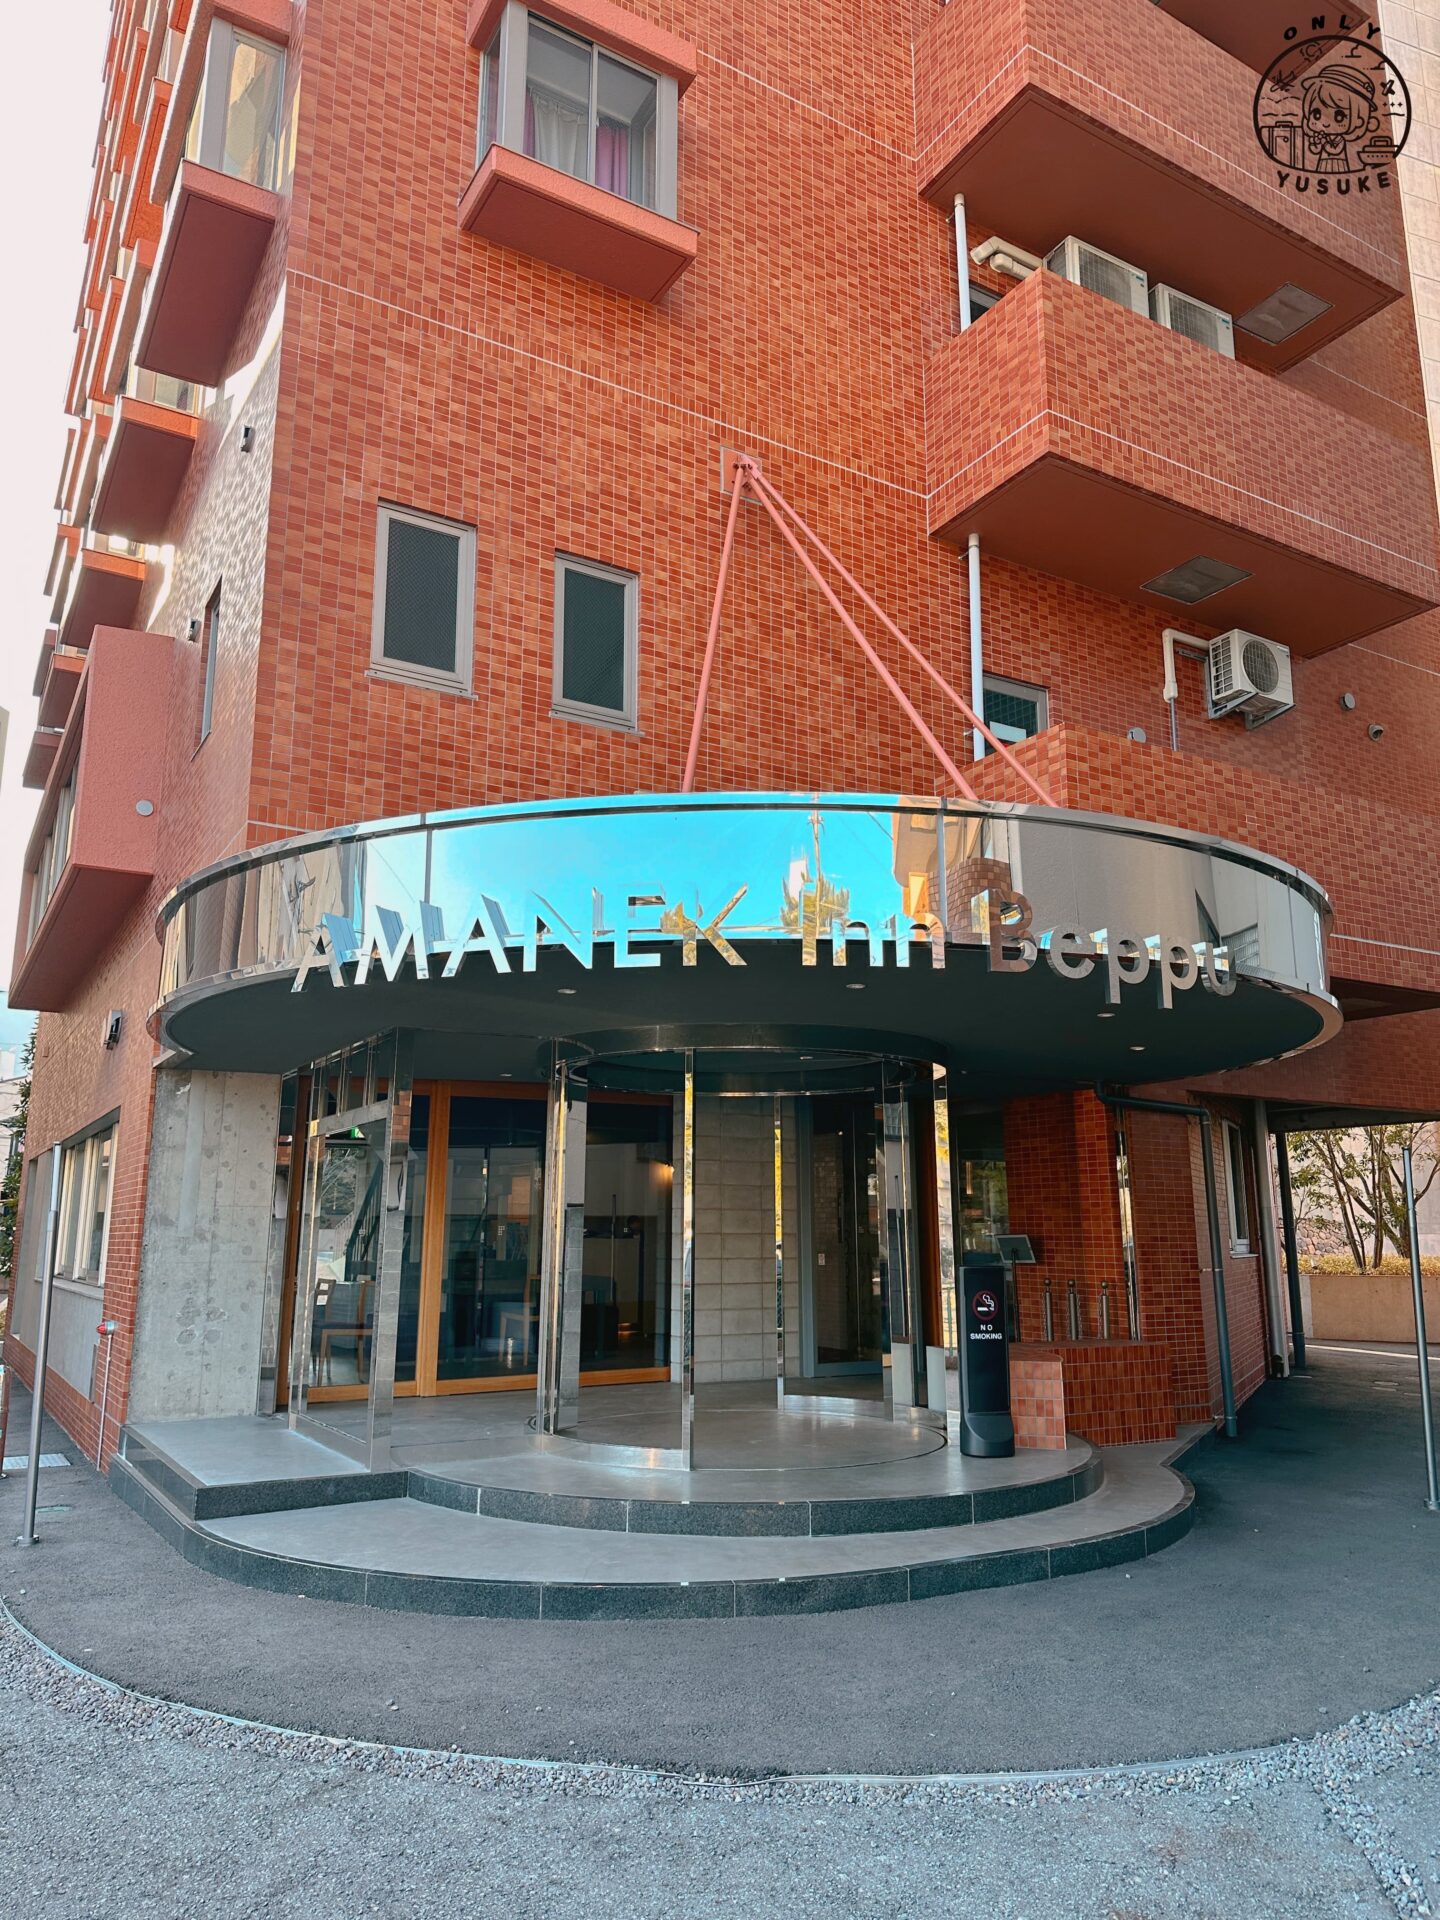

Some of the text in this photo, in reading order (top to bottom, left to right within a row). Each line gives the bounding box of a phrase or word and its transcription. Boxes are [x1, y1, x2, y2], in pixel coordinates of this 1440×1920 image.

[290, 882, 1238, 1009] AMANEK Inn Beppu
[970, 1332, 1002, 1340] SMOKING
